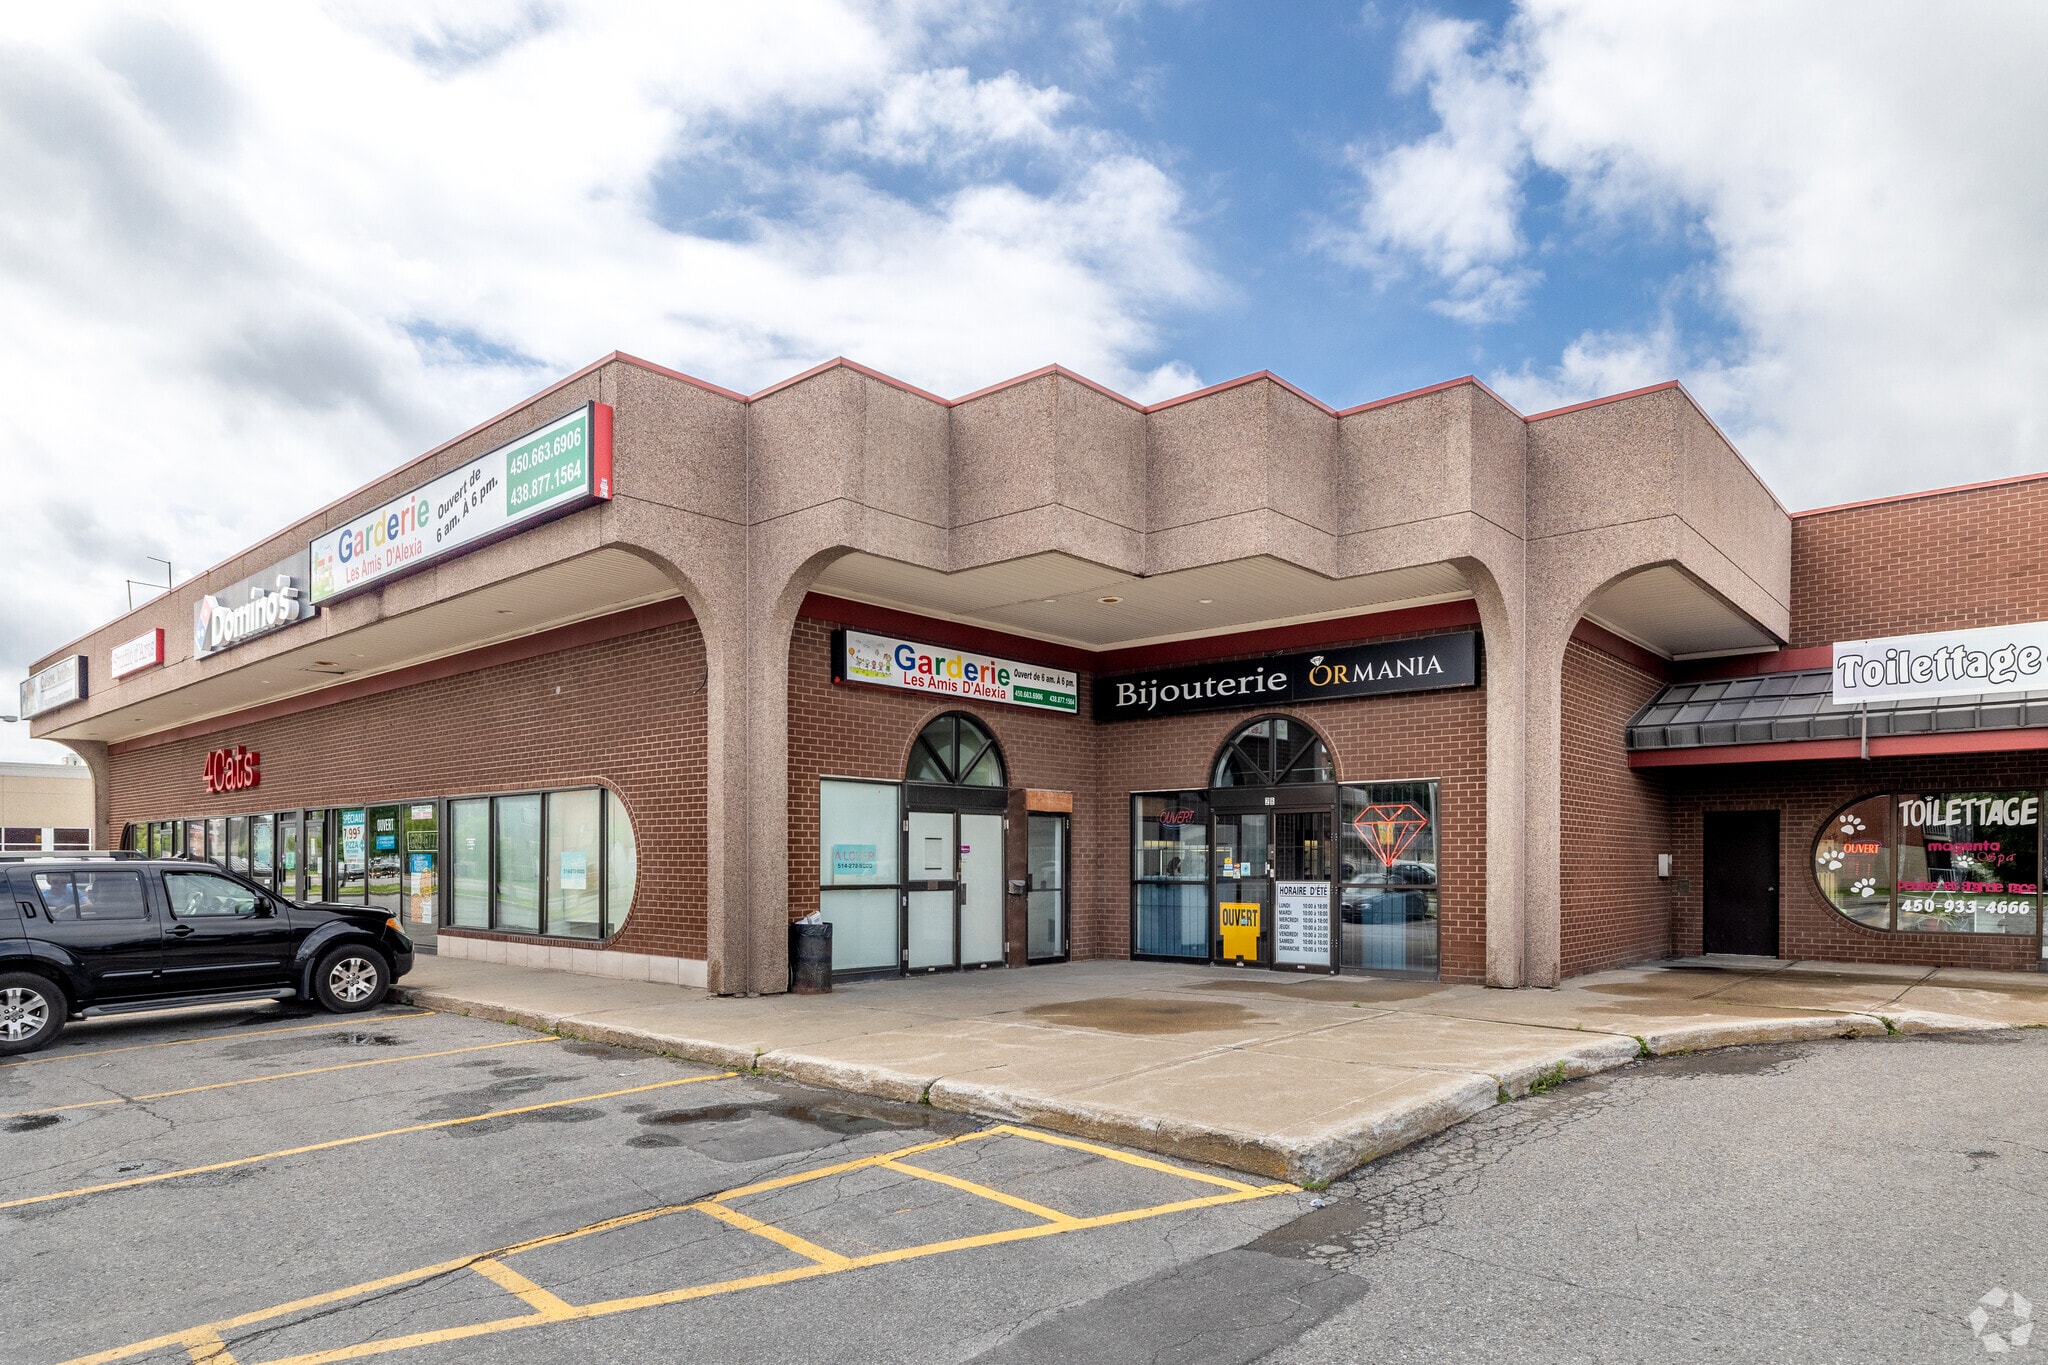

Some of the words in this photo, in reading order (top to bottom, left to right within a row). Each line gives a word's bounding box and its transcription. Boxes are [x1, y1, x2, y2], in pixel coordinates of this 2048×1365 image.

[510, 427, 581, 476] 450.663.6906
[438, 480, 467, 519] Ouvert
[470, 469, 481, 487] de
[510, 459, 581, 506] 438.877.1564
[339, 496, 430, 563] Garderie
[437, 528, 442, 542] 6
[444, 515, 460, 536] am.
[472, 492, 477, 507] 6
[480, 477, 498, 504] pm.
[346, 566, 360, 584] Les
[362, 555, 382, 577] Amis
[386, 538, 422, 567] D'Alexia
[211, 574, 299, 646] Domino's
[894, 644, 1010, 686] Garderie
[904, 671, 924, 687] Les
[928, 676, 958, 692] Amis
[963, 681, 1006, 699] D'Alexia
[1014, 668, 1032, 680] Ouvert
[1033, 672, 1040, 681] de
[1041, 673, 1045, 682] 6
[1061, 677, 1065, 686] 6
[1837, 644, 2042, 688] Toilettage
[1116, 667, 1287, 711] Bijouterie
[377, 818, 394, 831] OUVERT
[1160, 810, 1195, 824] OUVERT
[1844, 843, 1880, 854] OUVERT
[1928, 840, 2001, 854] magenta
[1279, 886, 1306, 895] HORAIRE
[1310, 885, 1327, 895] D'ÉTÉ
[1901, 900, 2030, 914] 450-933-4666
[1222, 908, 1258, 927] OUVERT
